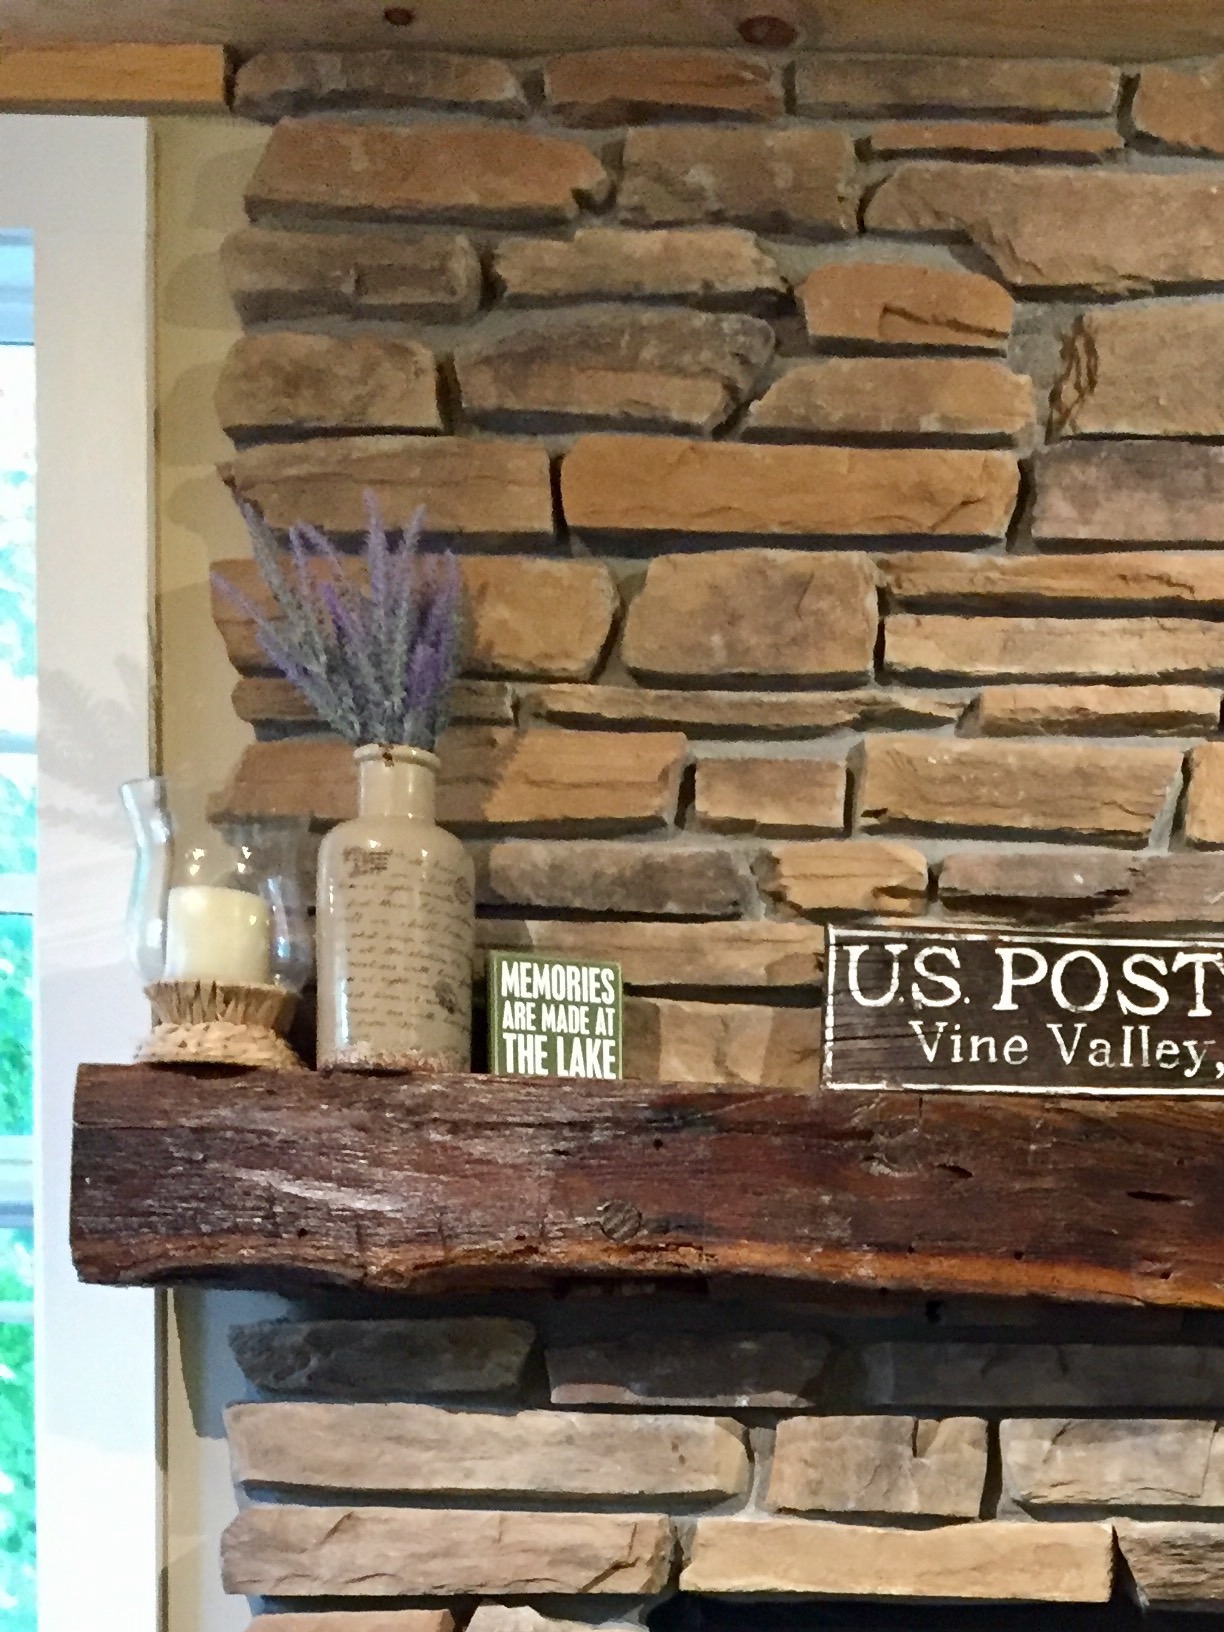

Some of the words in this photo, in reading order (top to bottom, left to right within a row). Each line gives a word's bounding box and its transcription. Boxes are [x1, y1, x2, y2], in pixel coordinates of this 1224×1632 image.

[501, 960, 615, 1004] MEMORIES
[842, 942, 970, 1008] U.S.
[502, 1000, 536, 1031] ARE
[541, 1003, 590, 1035] MADE
[595, 1007, 615, 1036] AT
[502, 1032, 549, 1075] THE
[556, 1036, 616, 1079] LAKE
[909, 1019, 1029, 1066] Vine
